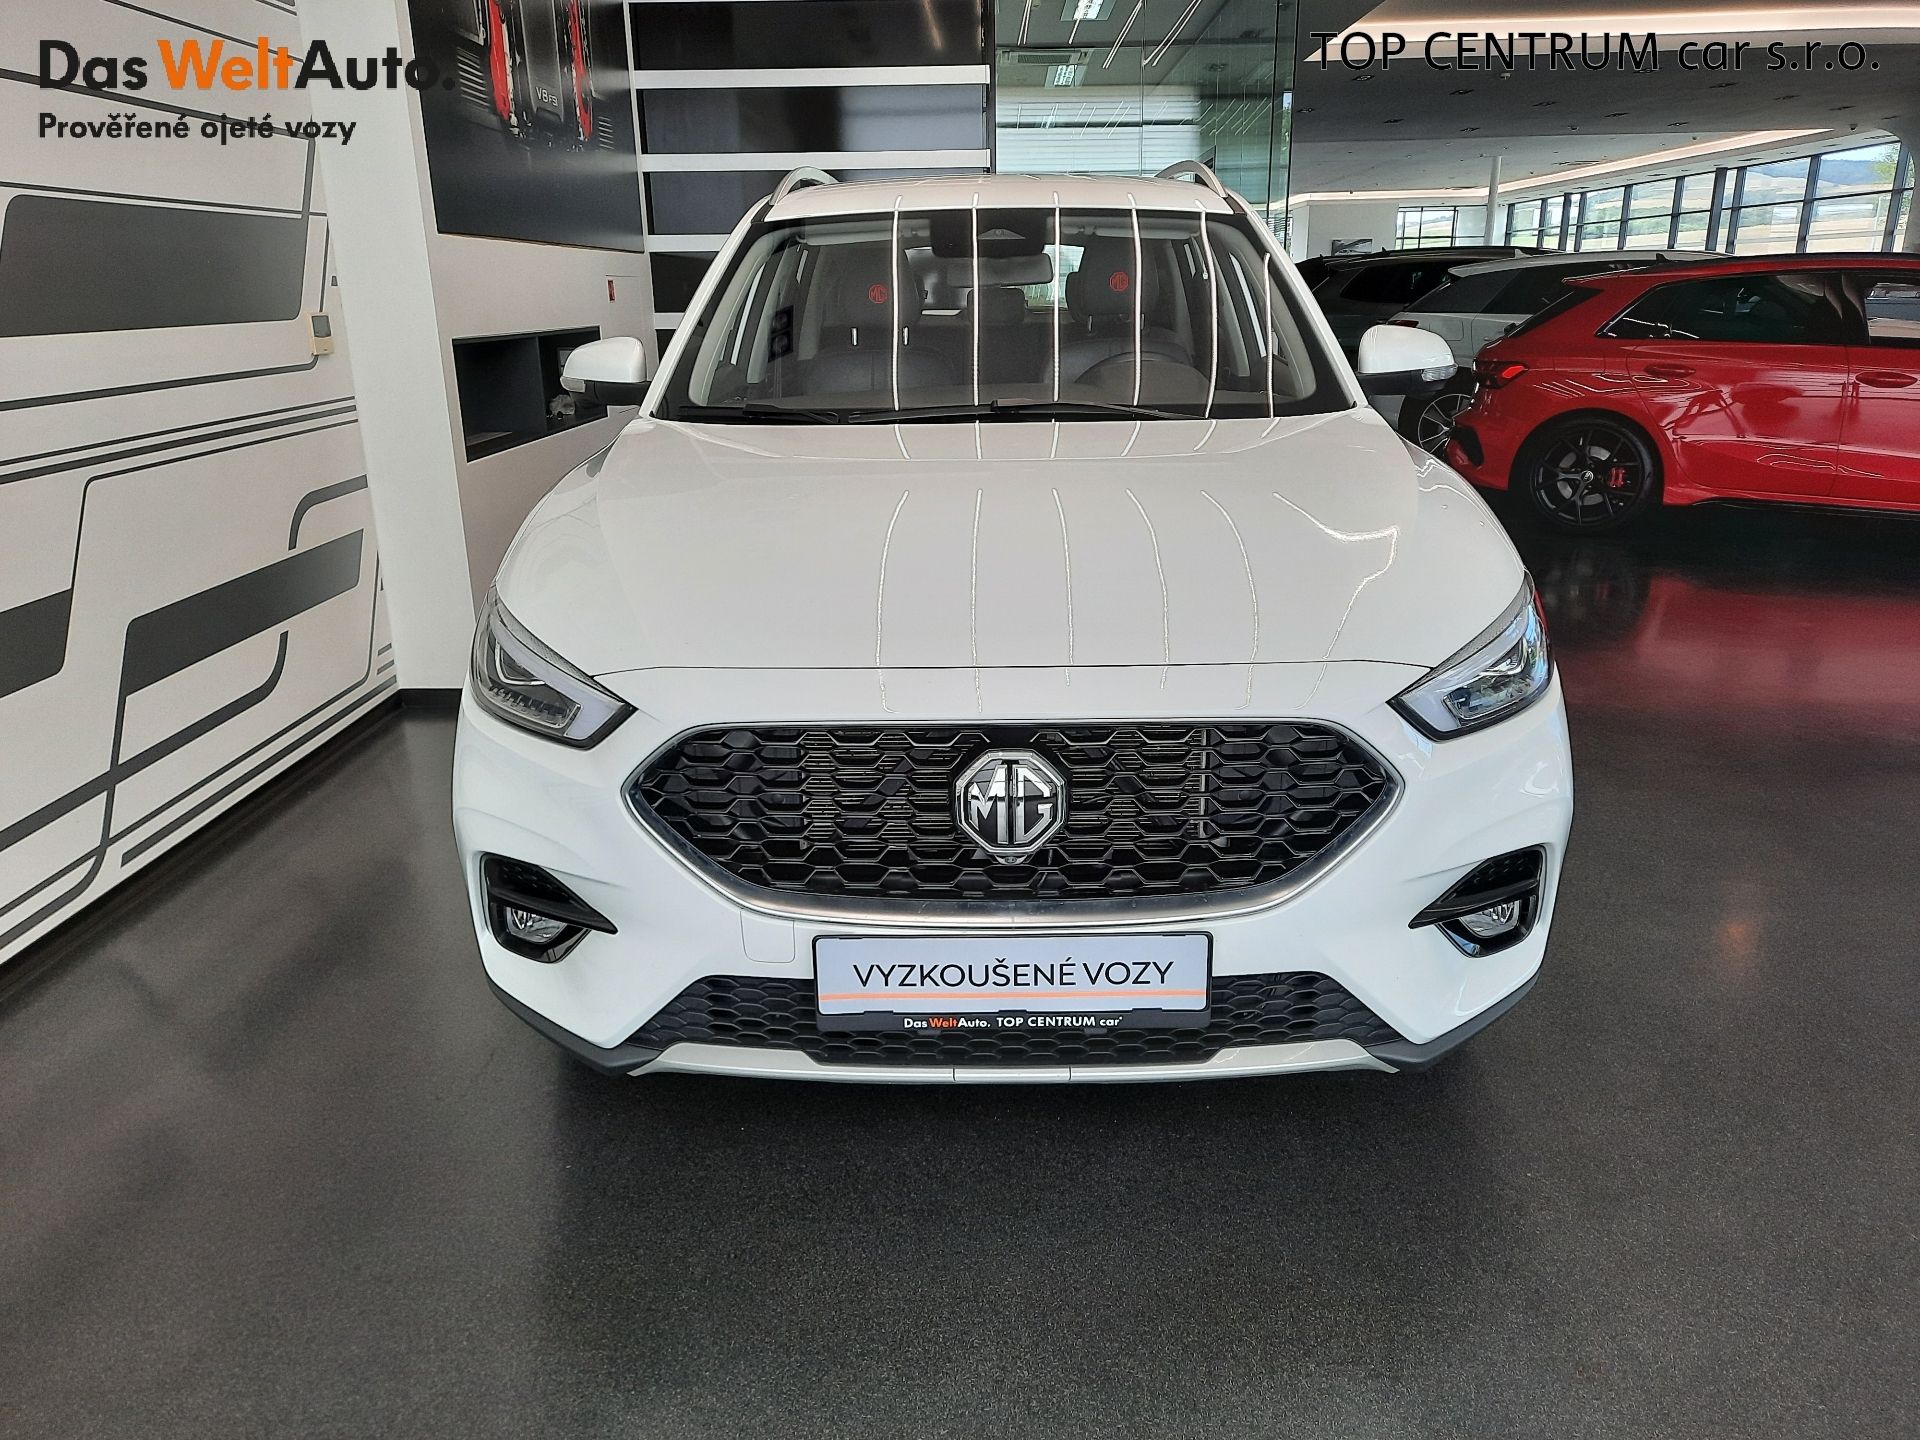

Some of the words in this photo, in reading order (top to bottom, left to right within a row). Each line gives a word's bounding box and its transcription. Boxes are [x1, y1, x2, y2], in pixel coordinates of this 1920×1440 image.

[968, 764, 1053, 844] MG
[853, 957, 1076, 988] VYZKOUŠENÉ
[1082, 961, 1174, 985] VOZY
[903, 1018, 928, 1029] Das
[996, 1016, 1024, 1028] TOP
[1027, 1016, 1096, 1027] CENTRUM
